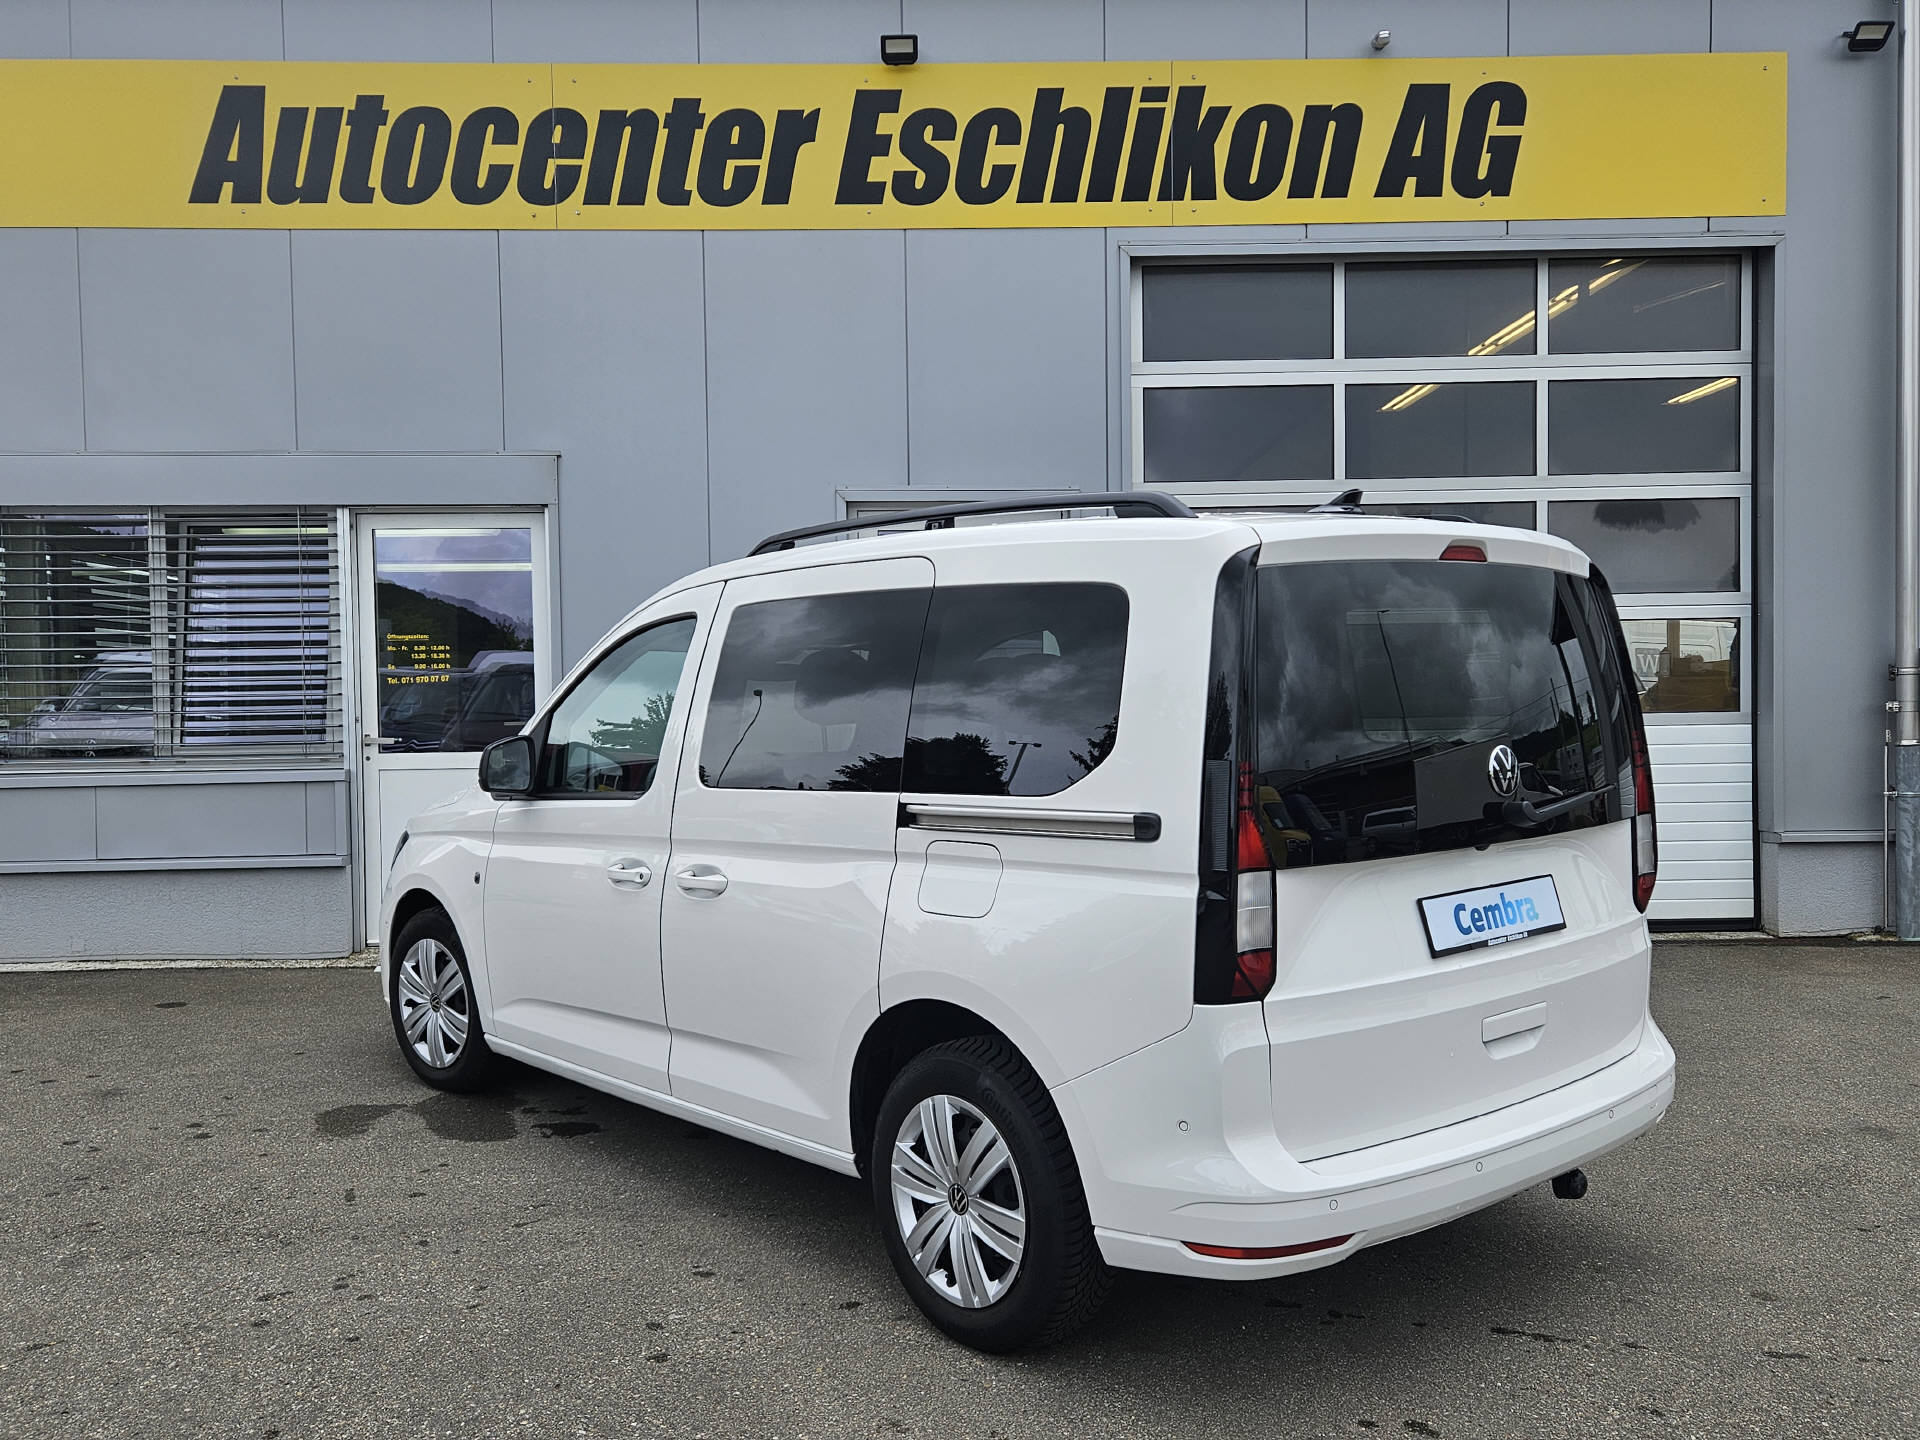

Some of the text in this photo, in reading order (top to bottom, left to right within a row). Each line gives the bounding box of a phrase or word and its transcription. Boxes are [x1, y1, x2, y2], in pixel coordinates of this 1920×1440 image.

[188, 81, 1528, 207] Autocenter Eschlikon AG
[402, 676, 413, 684] 071
[1454, 892, 1539, 935] Cembra
